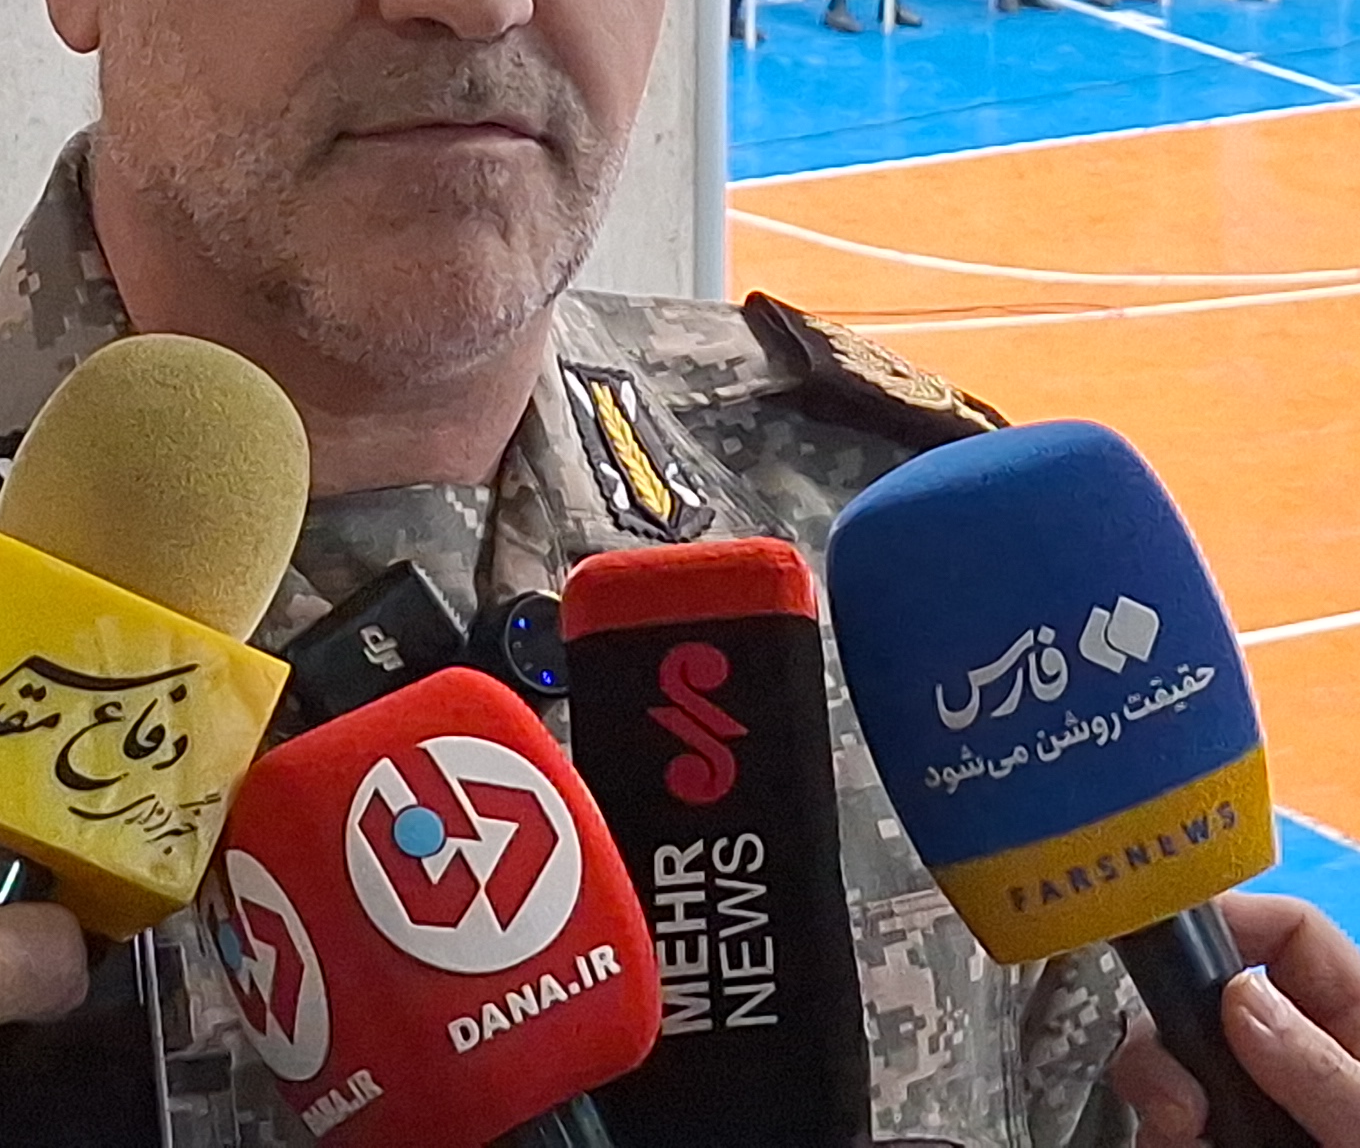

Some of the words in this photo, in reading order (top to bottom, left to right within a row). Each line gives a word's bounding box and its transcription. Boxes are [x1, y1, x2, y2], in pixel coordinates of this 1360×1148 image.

[935, 624, 1070, 731] فارس
[1123, 661, 1217, 713] حقیقت
[55, 683, 189, 791] دفاع
[1036, 709, 1123, 763] روشن
[654, 837, 714, 1037] MEHR
[712, 831, 779, 1029] NEWS
[447, 944, 622, 1054] DANA.IR
